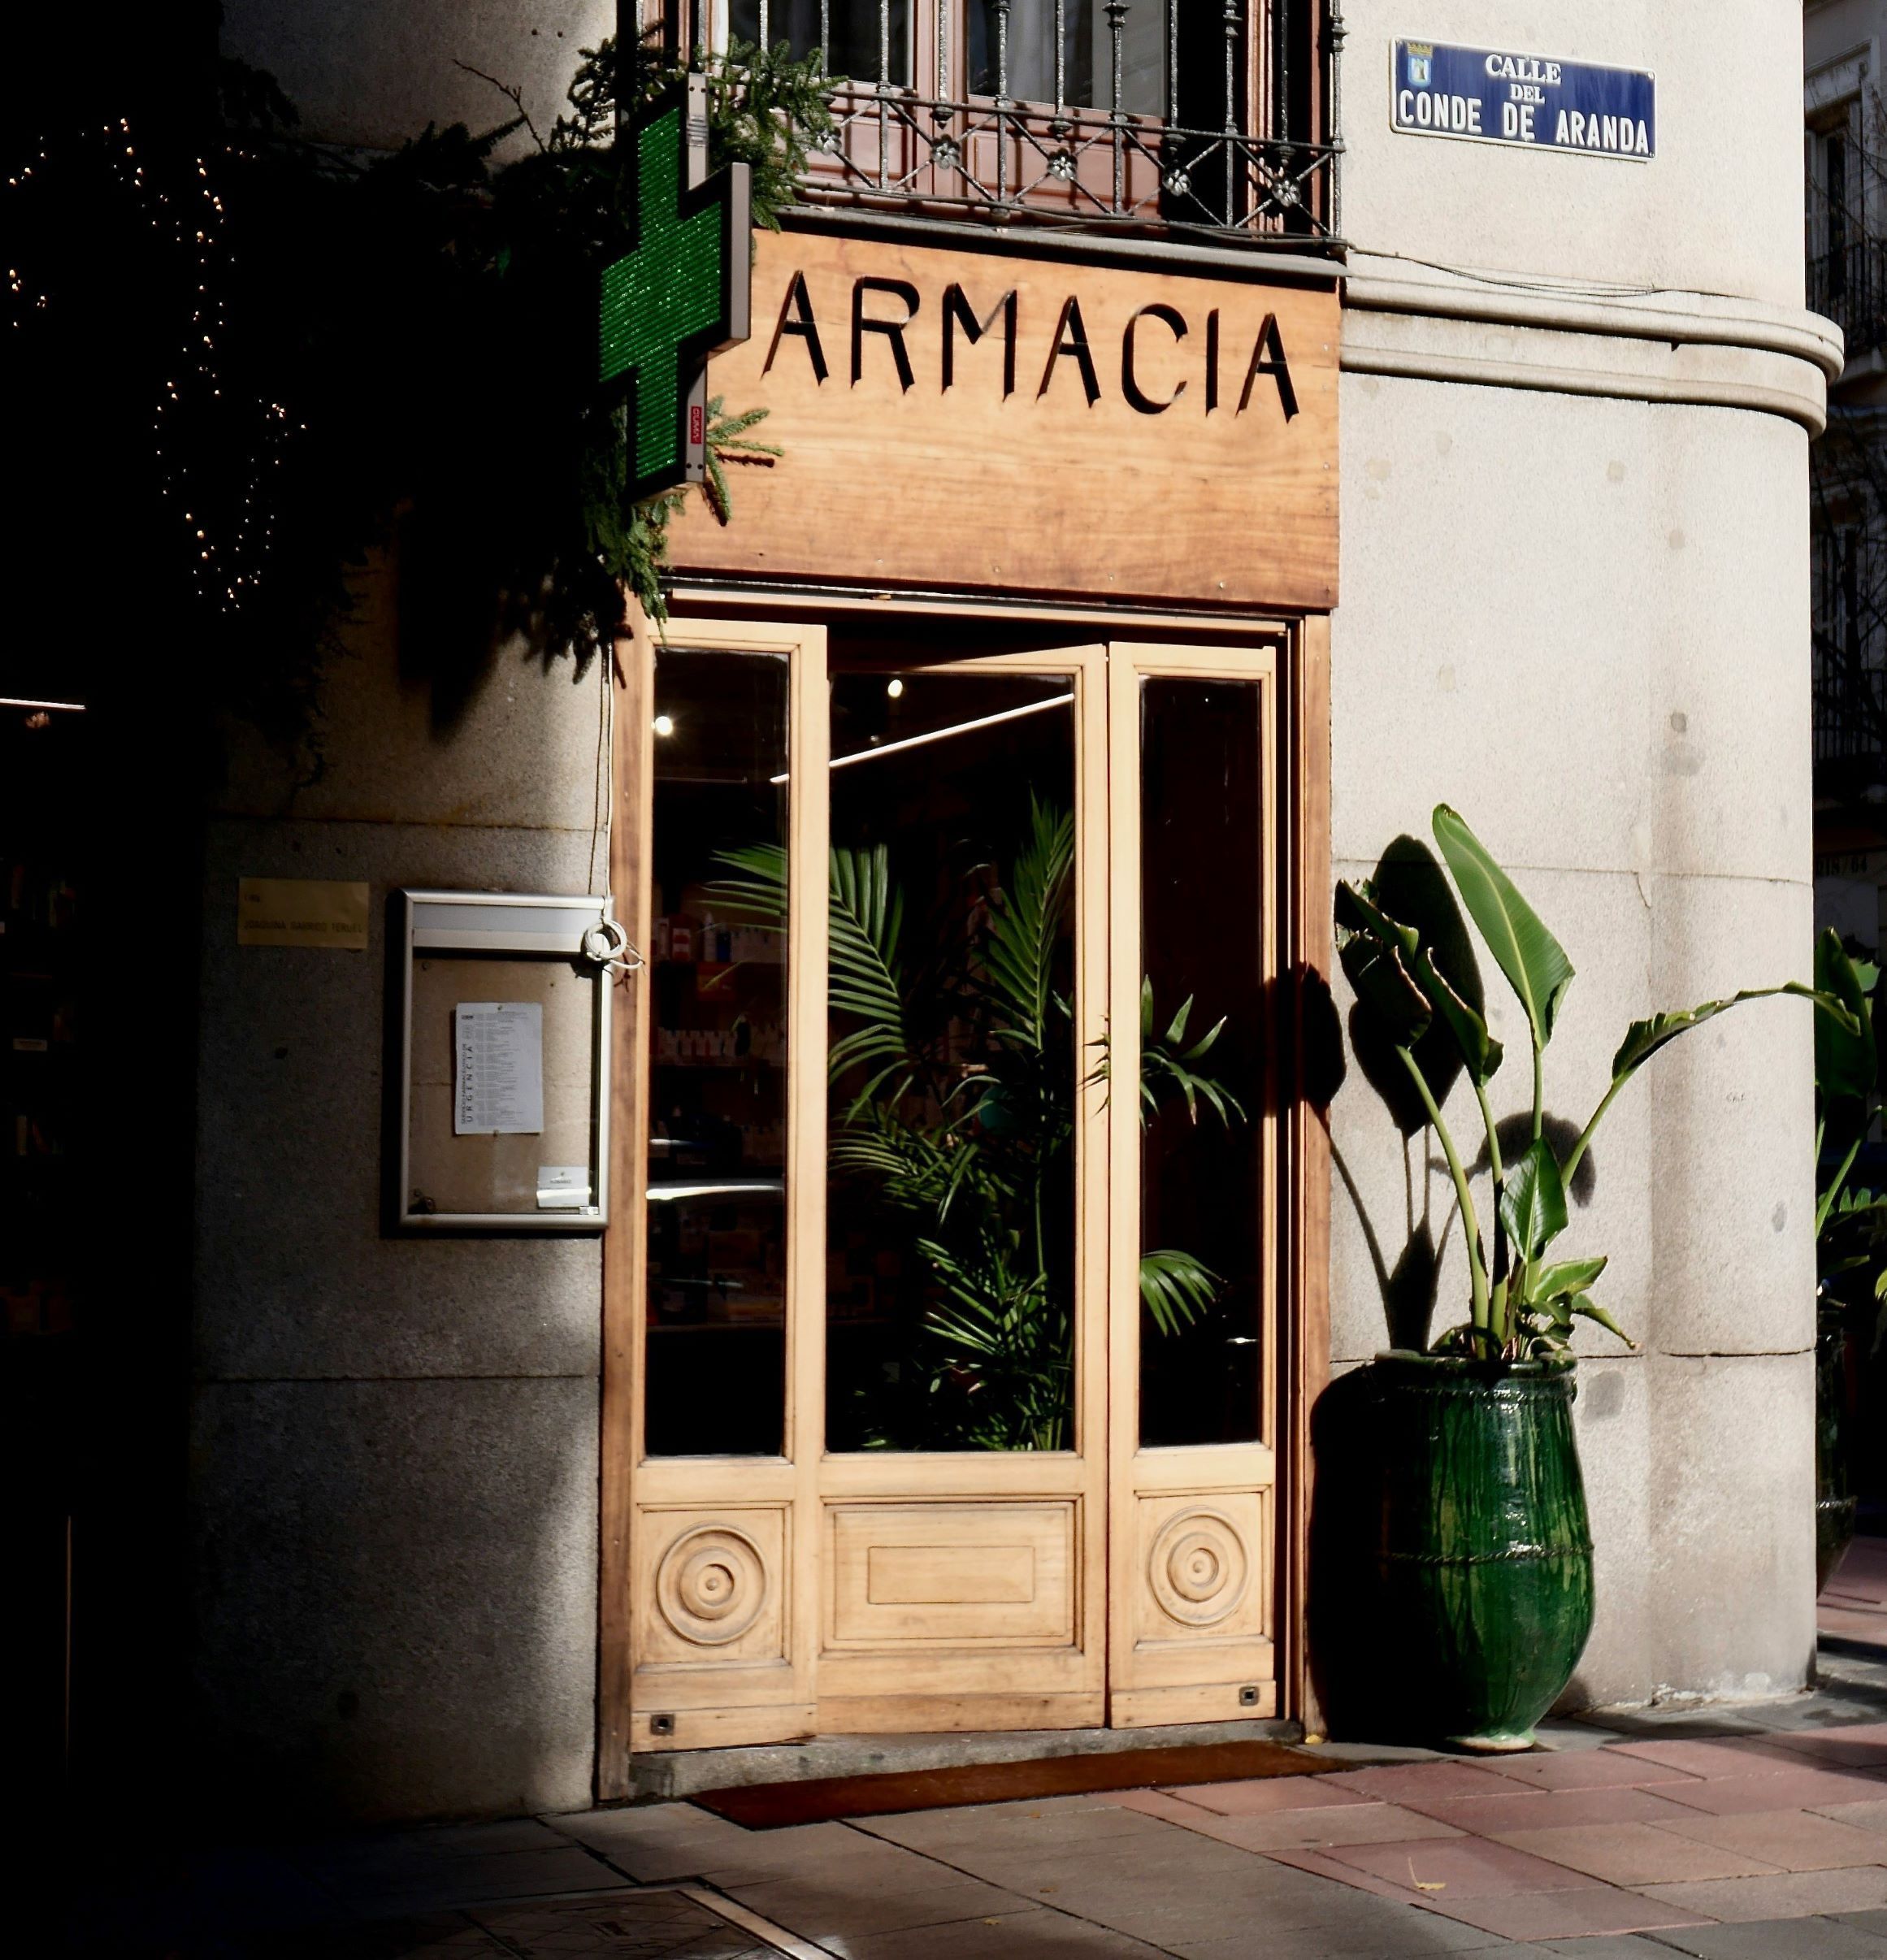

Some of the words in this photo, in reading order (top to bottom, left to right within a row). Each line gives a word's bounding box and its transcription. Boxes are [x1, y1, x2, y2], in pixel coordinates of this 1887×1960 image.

[1485, 54, 1561, 85] CALLE
[1510, 83, 1546, 103] DEL
[1399, 89, 1482, 133] CONDE
[1503, 102, 1535, 140] DE
[1555, 109, 1649, 154] ARANDA
[761, 269, 1299, 424] ARMACIA
